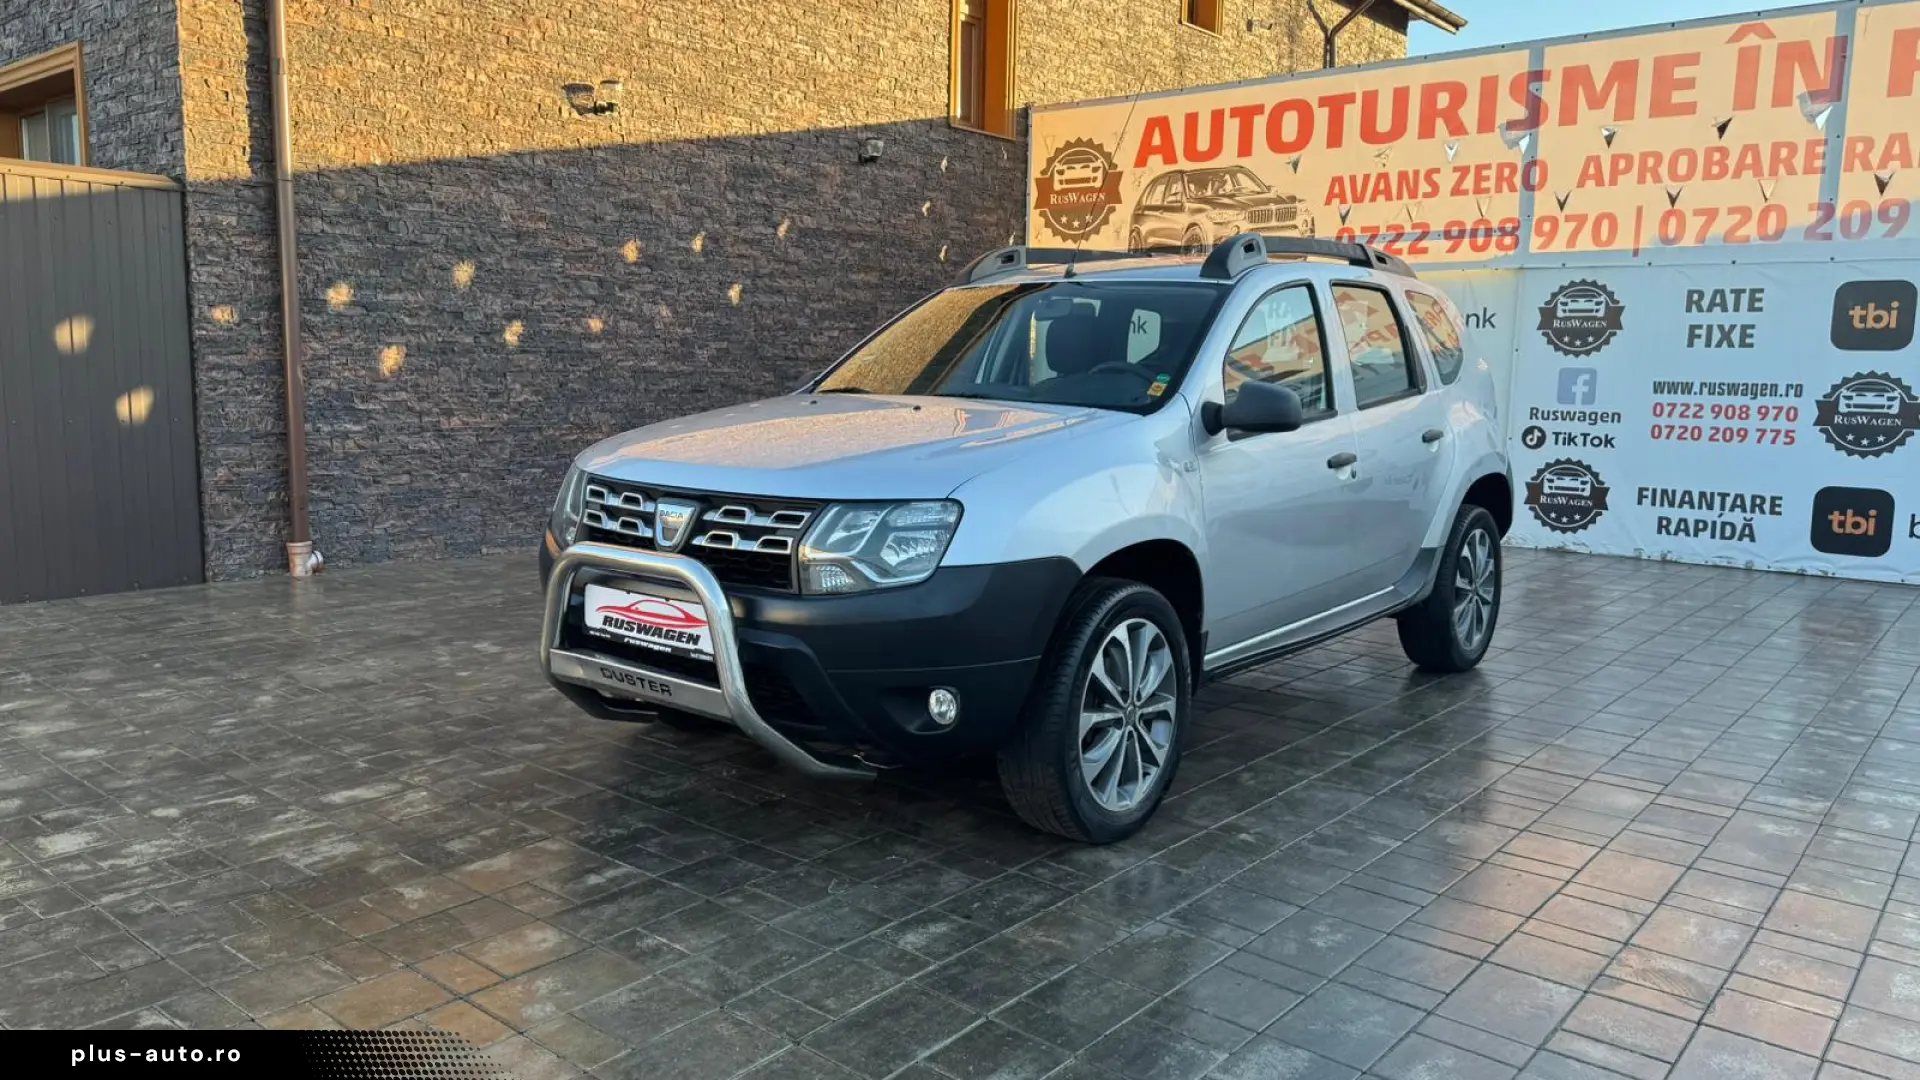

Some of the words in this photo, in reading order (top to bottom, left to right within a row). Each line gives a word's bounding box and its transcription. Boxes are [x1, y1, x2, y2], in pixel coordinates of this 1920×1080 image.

[1133, 52, 1701, 168] AUTOTURISME
[1725, 22, 1848, 111] ÎN
[1324, 167, 1440, 206] AVANS
[1450, 159, 1549, 197] ZERO
[1576, 138, 1828, 189] APROBARE
[1842, 132, 1920, 173] RA
[1443, 216, 1521, 253] 908
[1533, 210, 1619, 251] 970
[1658, 203, 1789, 246] 0720
[1804, 197, 1911, 241] 209
[1685, 288, 1765, 313] RATE
[1848, 300, 1900, 330] tbi
[1686, 323, 1756, 349] FIXE
[1652, 380, 1804, 400] www.ruswagen.ro
[1529, 407, 1622, 425] Ruswagen
[1652, 401, 1704, 419] 0722
[1710, 403, 1751, 421] 908
[1757, 405, 1799, 423] 970
[1552, 431, 1616, 448] TikTok
[1650, 424, 1703, 441] 0720
[1708, 426, 1749, 444] 209
[1755, 428, 1797, 446] 775
[1636, 486, 1783, 517] FINANȚARE
[1656, 515, 1757, 543] RAPIDĂ
[1828, 508, 1878, 537] tbi
[601, 615, 702, 646] RUSWAGEN
[600, 667, 673, 697] DUSTER
